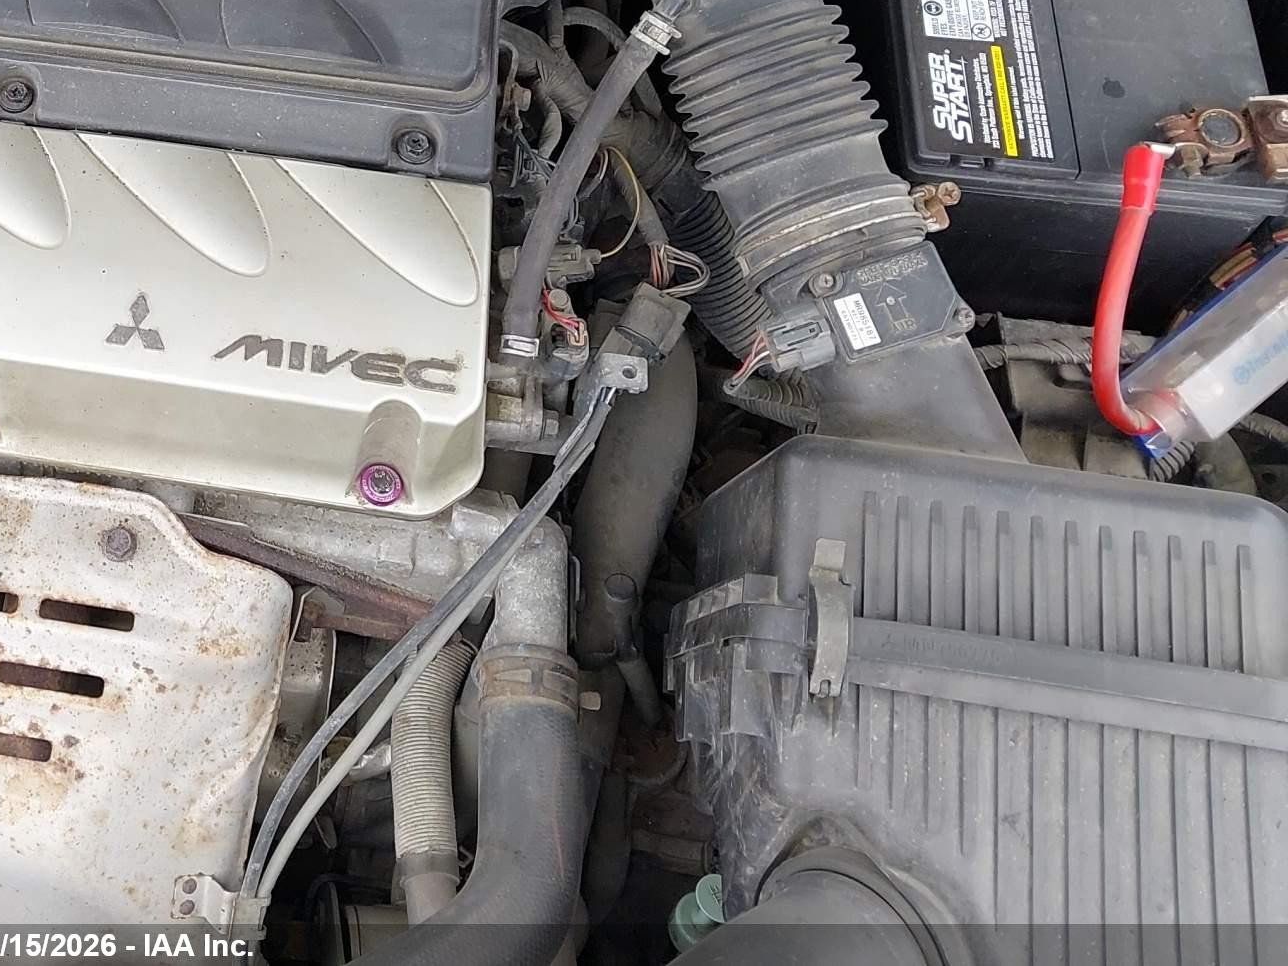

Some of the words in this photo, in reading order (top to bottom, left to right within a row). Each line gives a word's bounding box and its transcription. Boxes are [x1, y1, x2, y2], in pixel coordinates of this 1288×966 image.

[946, 10, 956, 36] EXPLOSIVE
[928, 52, 952, 130] SUPER
[944, 50, 973, 144] START
[211, 334, 458, 394] MIVEC
